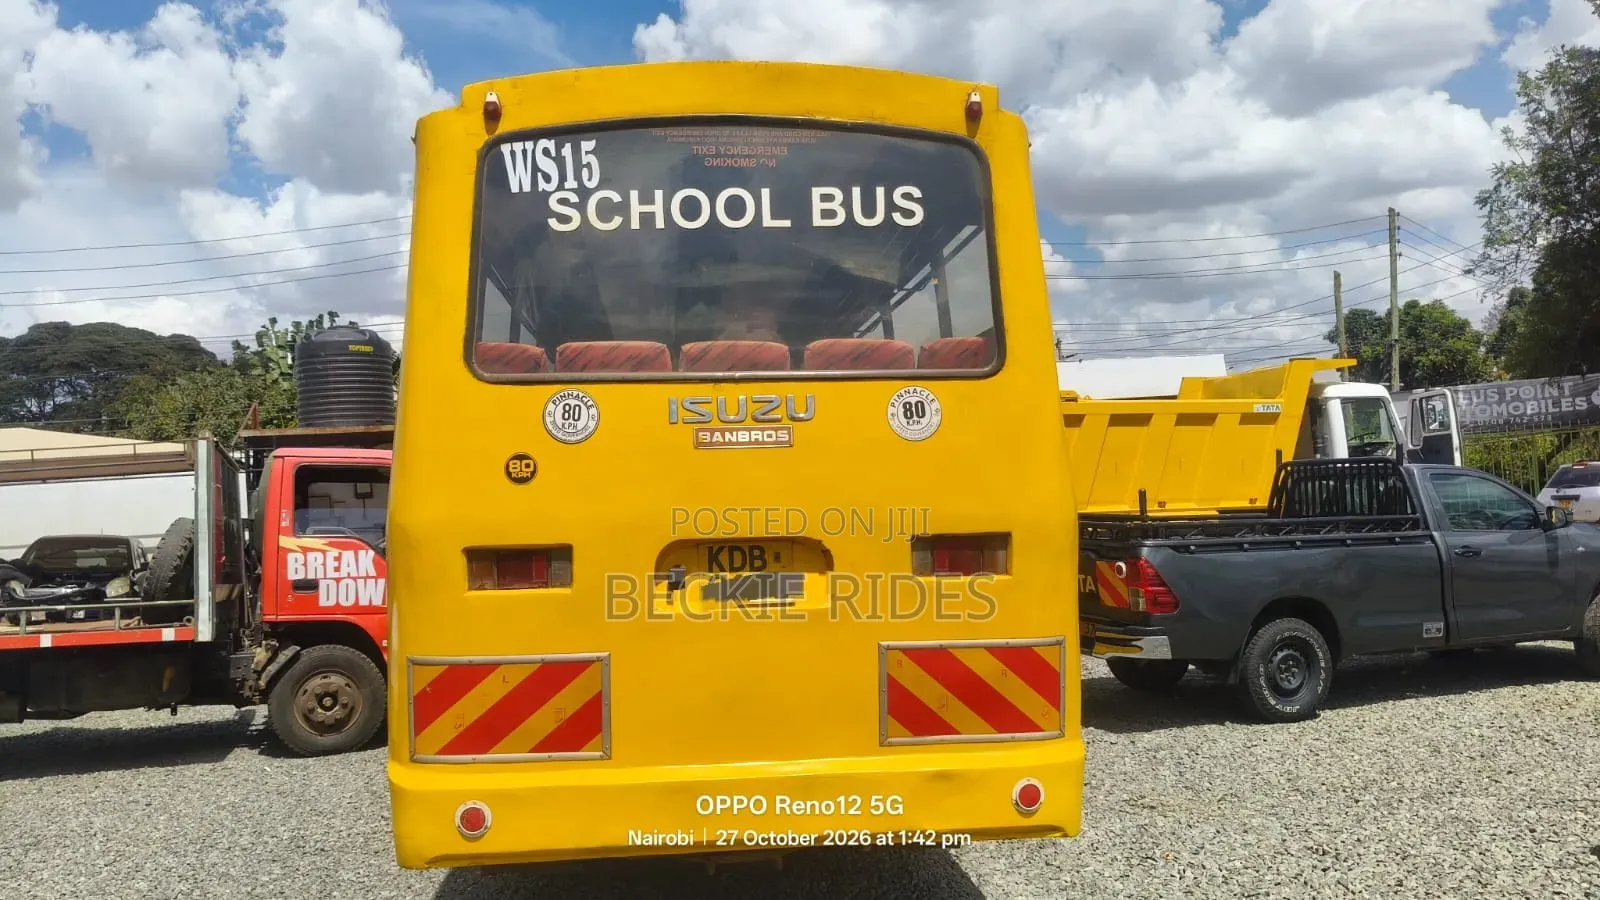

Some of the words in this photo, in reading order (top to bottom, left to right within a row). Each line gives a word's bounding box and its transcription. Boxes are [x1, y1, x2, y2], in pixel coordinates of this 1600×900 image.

[501, 138, 600, 193] WS15
[547, 187, 792, 232] SCHOOL
[811, 186, 925, 228] BUS
[552, 391, 595, 410] PINNACLE
[890, 388, 936, 408] PINNACLE
[1458, 387, 1499, 403] LUS
[1505, 381, 1574, 401] POINT
[561, 402, 582, 422] 80
[669, 394, 815, 424] ISUZU
[902, 400, 926, 420] 80
[1262, 404, 1281, 412] TATA
[1459, 397, 1588, 421] TOMOBILES
[698, 430, 789, 443] BANBROS
[508, 459, 534, 472] 80
[511, 471, 531, 479] KPH
[287, 549, 377, 580] BREAK
[707, 544, 768, 573] KDB
[318, 578, 386, 606] DOW
[1078, 575, 1096, 592] TA
